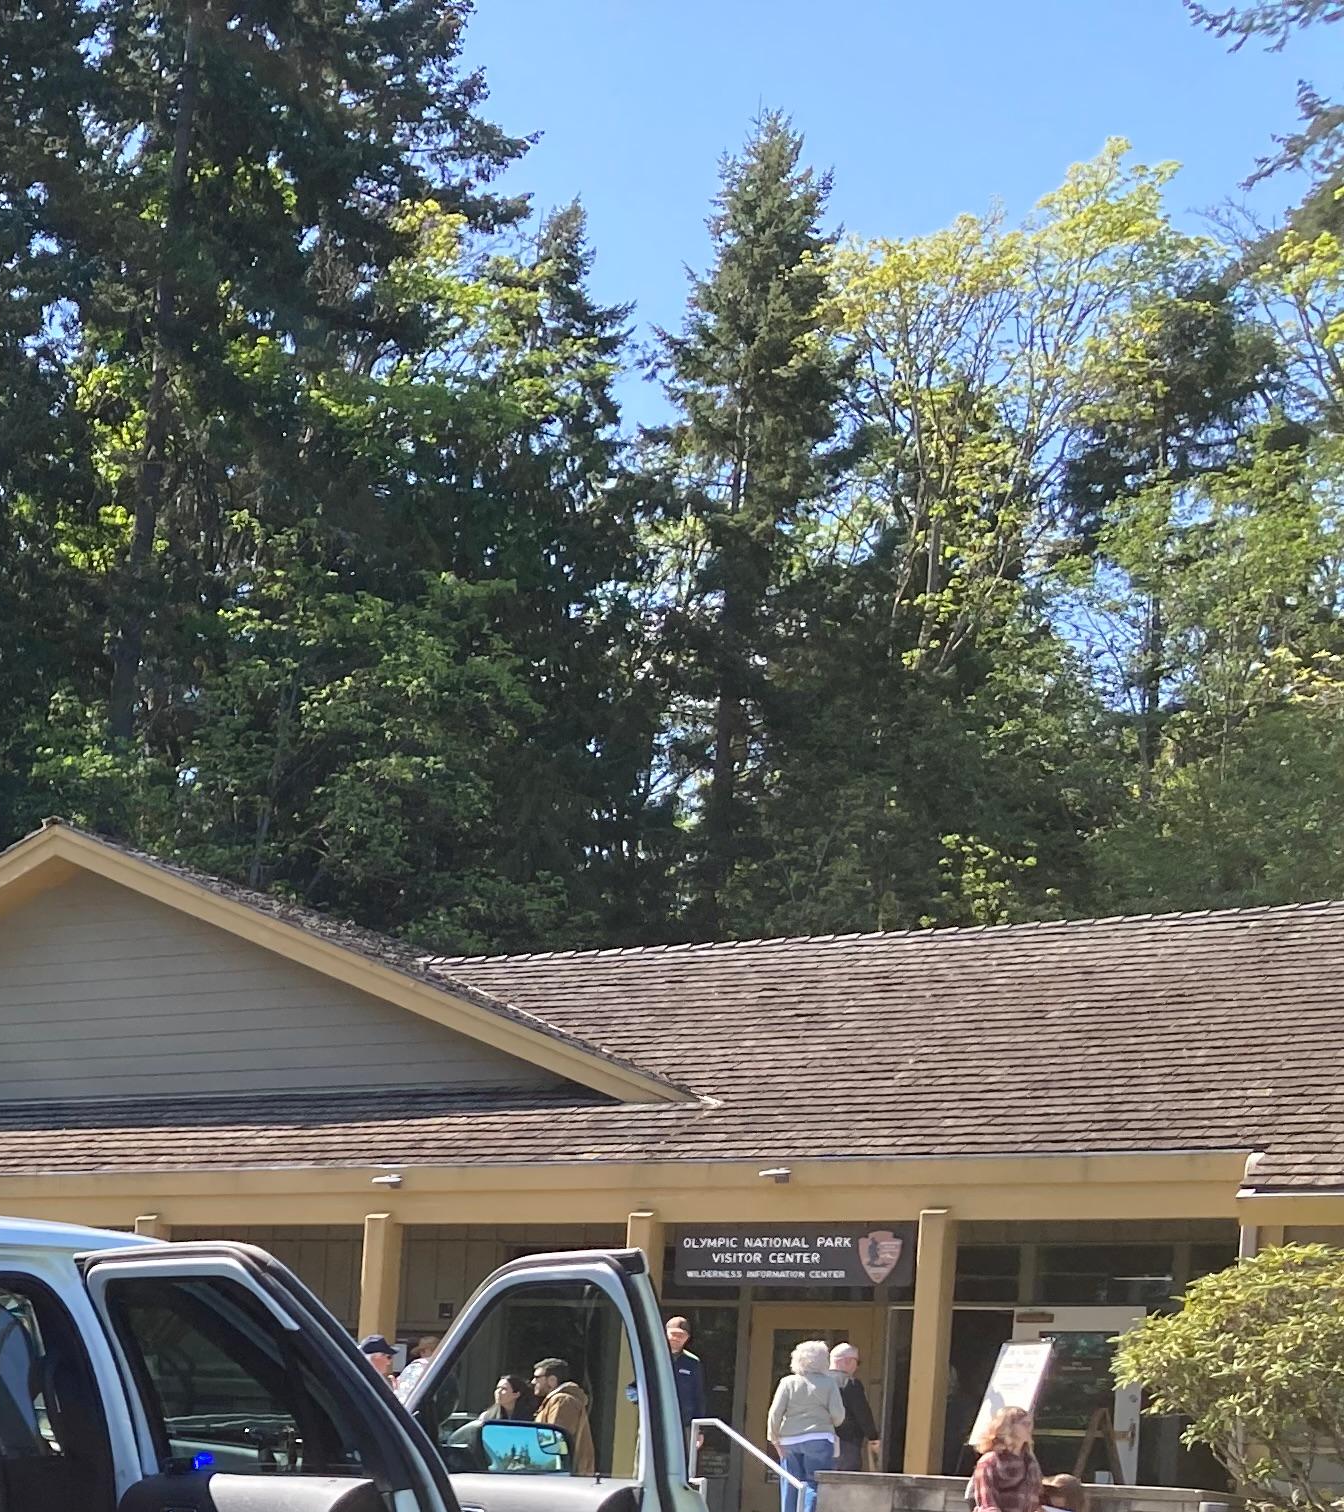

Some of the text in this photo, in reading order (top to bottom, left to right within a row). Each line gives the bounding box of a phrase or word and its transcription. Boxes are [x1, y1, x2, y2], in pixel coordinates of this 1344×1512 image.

[683, 1236, 852, 1249] OLYMPIC NATIONAL PARK
[712, 1252, 821, 1264] VISITOR CENTER
[686, 1270, 845, 1279] WILDERNESS INFORMATION CENTER
